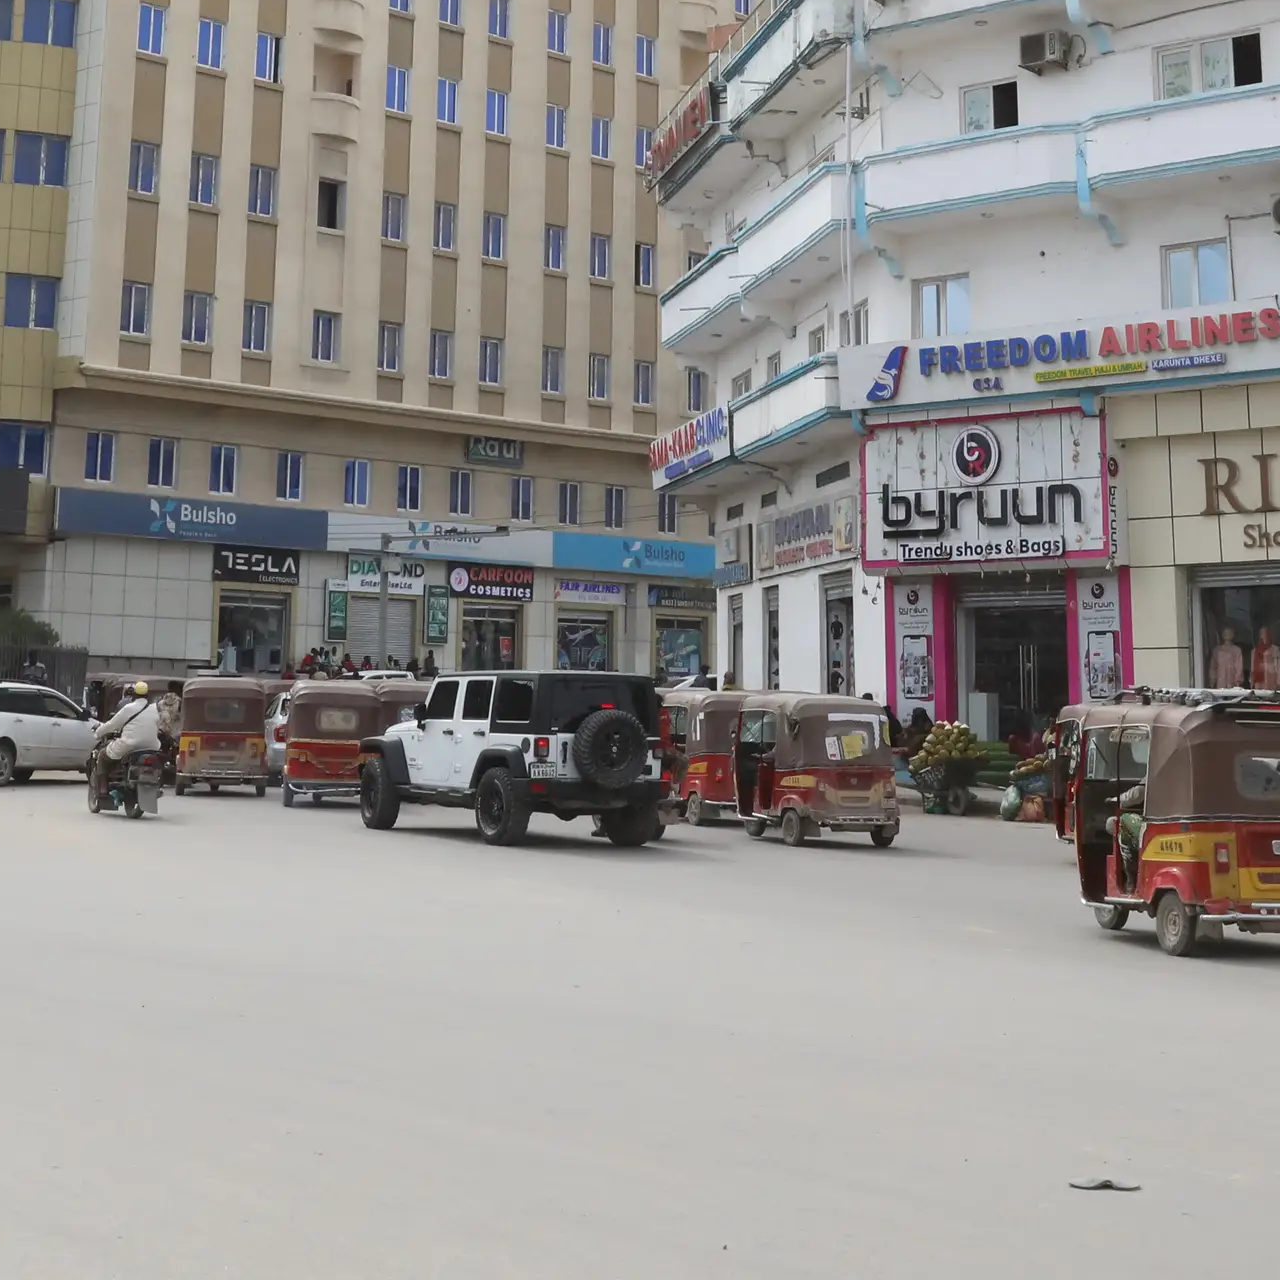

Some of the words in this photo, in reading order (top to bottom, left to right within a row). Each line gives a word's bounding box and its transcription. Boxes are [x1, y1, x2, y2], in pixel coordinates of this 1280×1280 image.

[920, 330, 1088, 377] FREEDOM
[180, 503, 237, 525] Bulsho
[882, 484, 1082, 539] byruun
[644, 544, 685, 562] Bulsho
[900, 542, 953, 561] Trendy
[955, 541, 1003, 557] shoes
[1005, 540, 1016, 556] &
[221, 551, 296, 574] TESLA
[470, 585, 531, 598] COSMETICS
